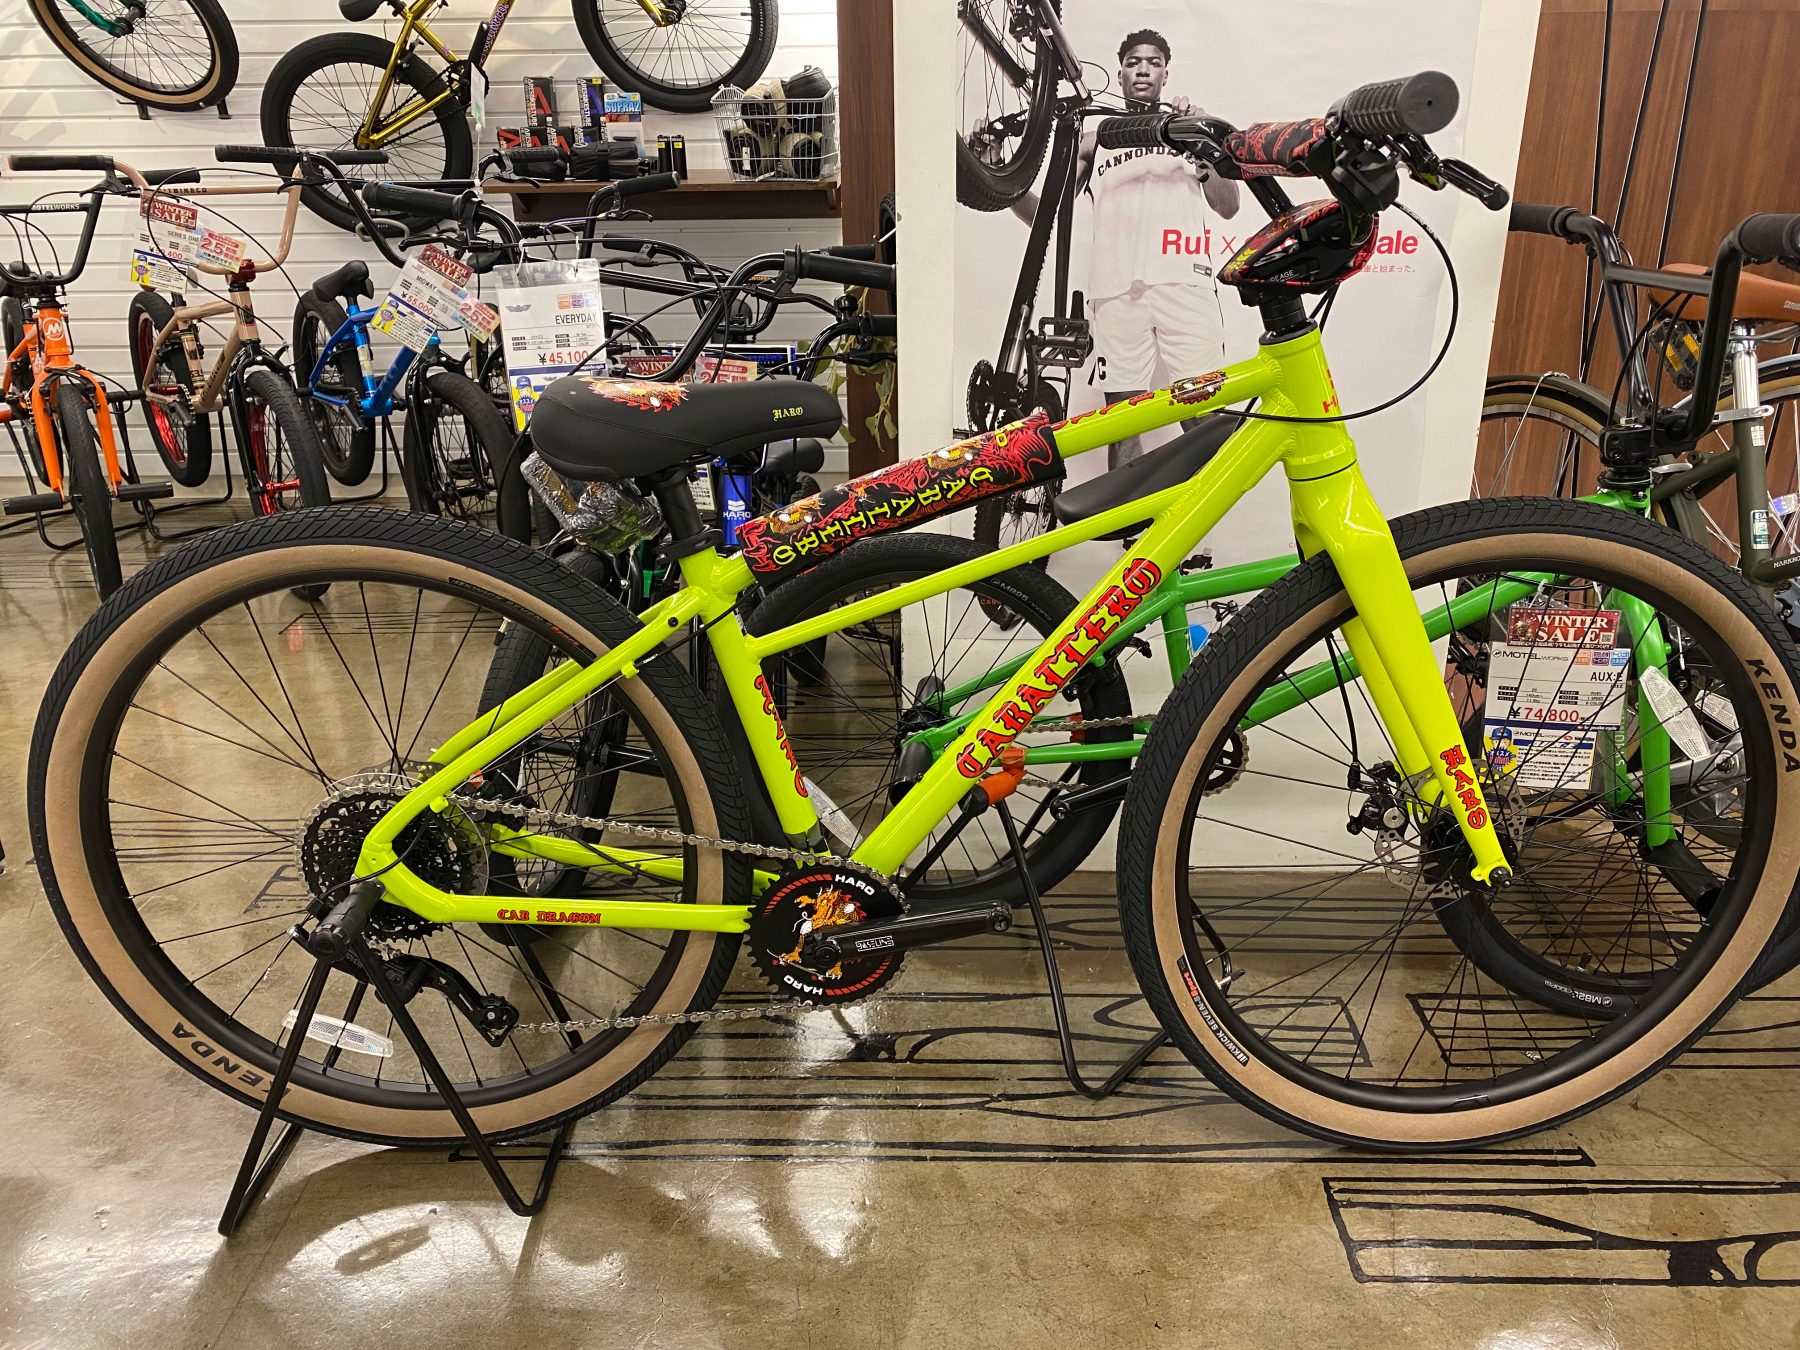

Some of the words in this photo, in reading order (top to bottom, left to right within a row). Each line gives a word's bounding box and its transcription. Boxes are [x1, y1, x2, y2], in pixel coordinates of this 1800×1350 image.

[153, 208, 189, 224] SALE
[154, 201, 192, 218] WINTER
[1161, 229, 1211, 255] Rui
[429, 259, 463, 280] SALE
[435, 252, 468, 276] WINTER
[555, 313, 598, 325] EVERYDAY
[772, 406, 804, 422] HARO
[722, 511, 752, 519] HARO
[1536, 614, 1608, 629] WINTER
[1535, 627, 1600, 644] SALE
[956, 558, 1162, 778] CABALLERO
[1745, 659, 1800, 773] KENDA
[1440, 744, 1487, 830] HARO
[834, 873, 876, 896] HARO
[497, 908, 530, 921] CAB
[783, 973, 824, 996] HARO
